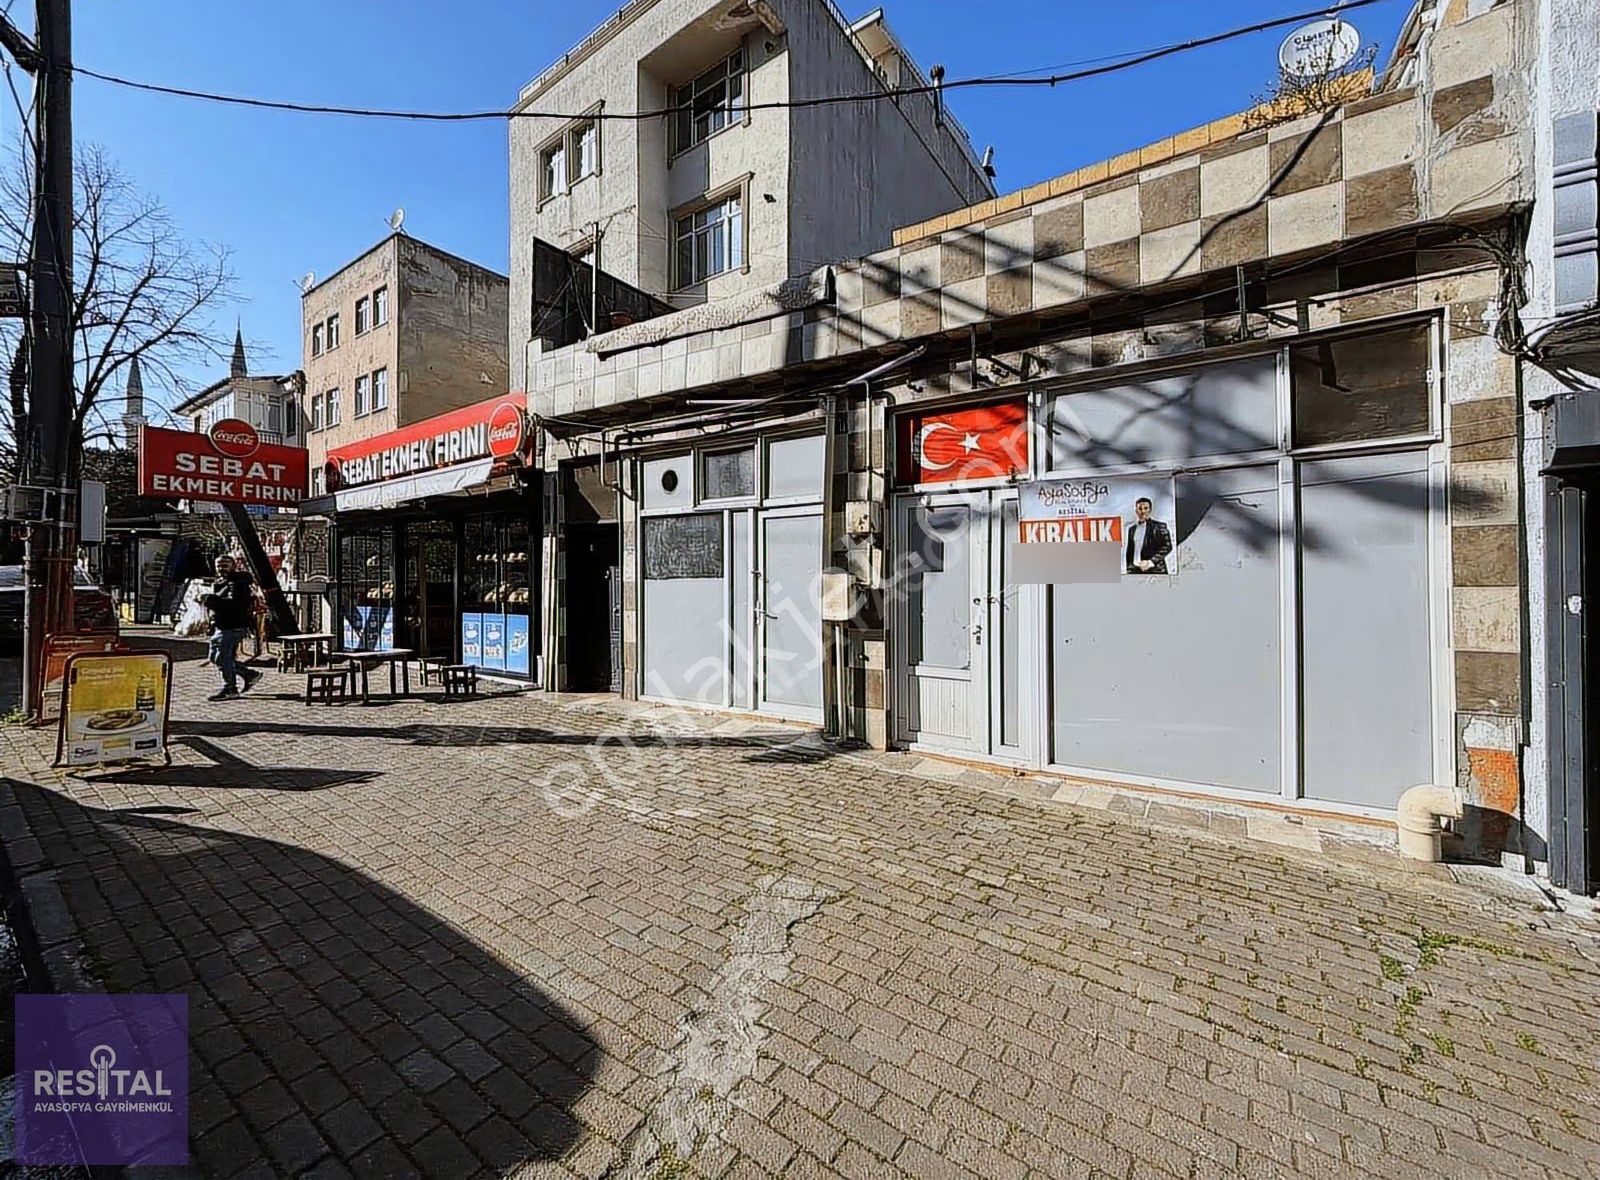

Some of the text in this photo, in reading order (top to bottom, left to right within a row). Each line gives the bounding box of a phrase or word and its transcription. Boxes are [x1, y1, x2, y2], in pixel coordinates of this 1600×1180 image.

[175, 452, 286, 482] SEBAT
[342, 422, 485, 485] SEBAT EKMEK FIRINI
[153, 474, 302, 501] EKMEK FIRINI
